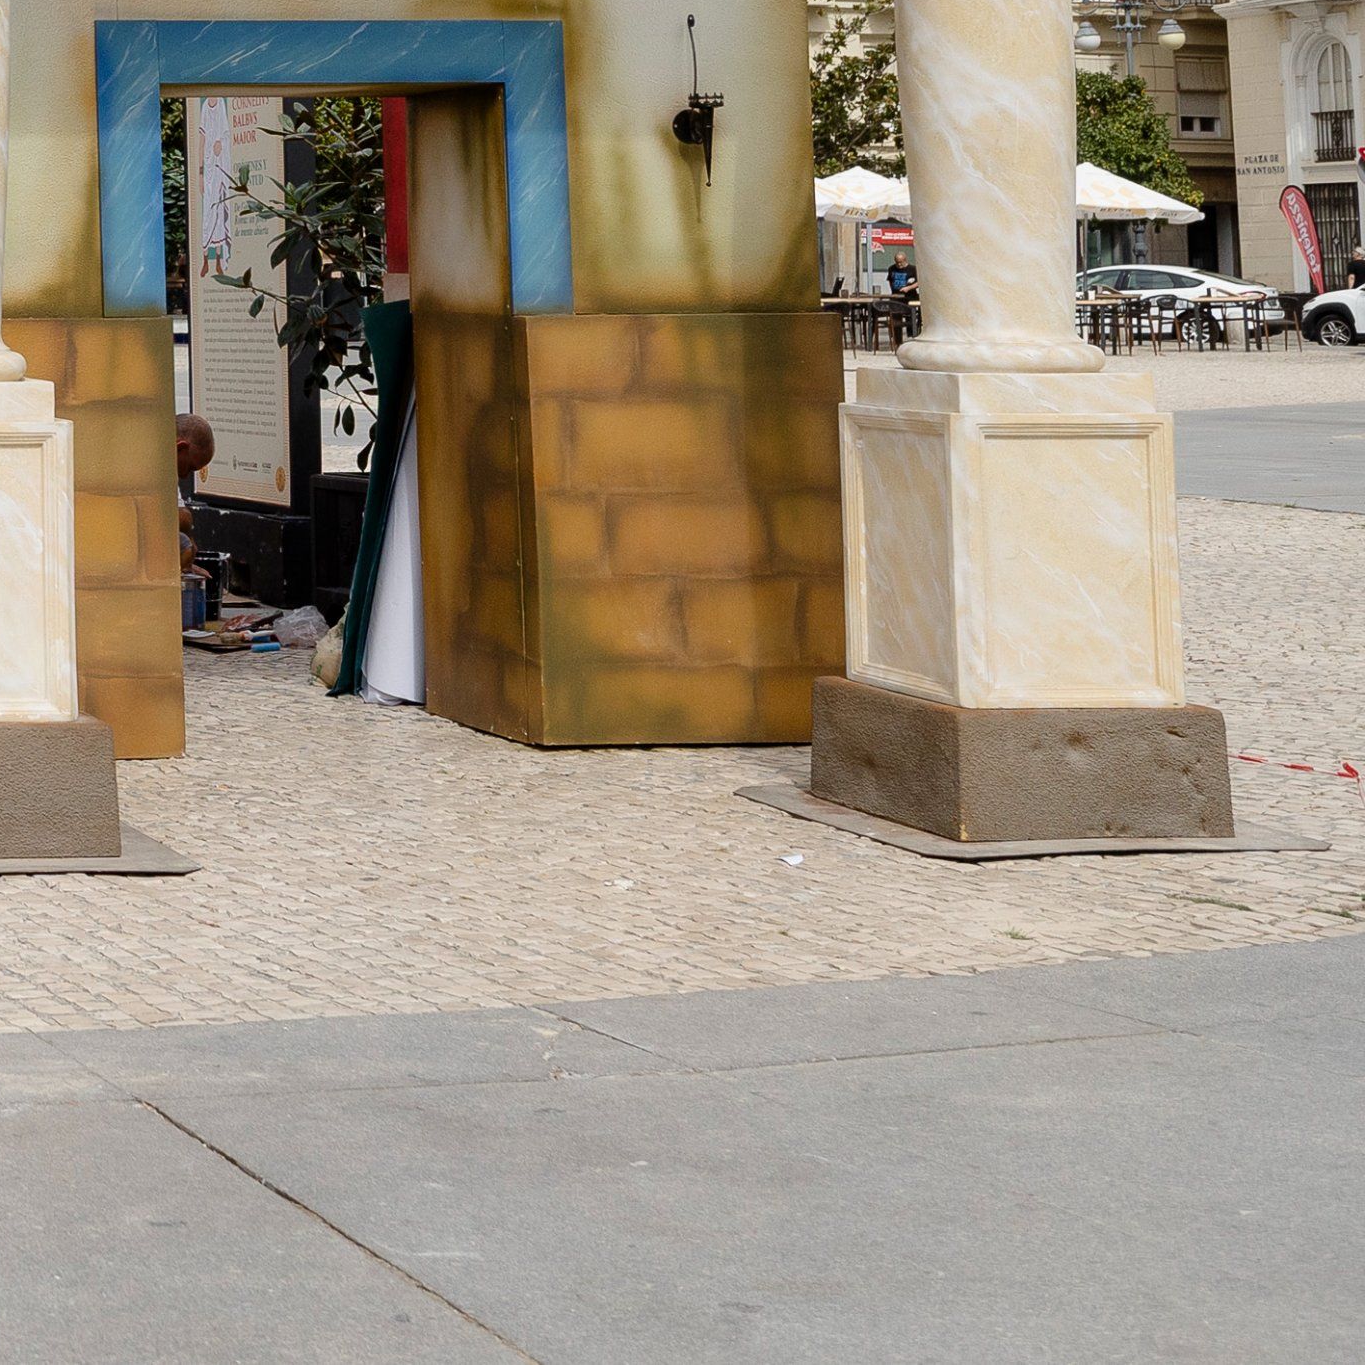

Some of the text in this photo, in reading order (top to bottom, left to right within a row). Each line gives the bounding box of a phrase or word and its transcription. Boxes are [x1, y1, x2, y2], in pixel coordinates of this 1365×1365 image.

[232, 111, 258, 128] BALBVS
[233, 130, 257, 146] MAIOR
[1244, 154, 1279, 164] PLAZA DE
[1237, 166, 1285, 175] SAN ANTONIO
